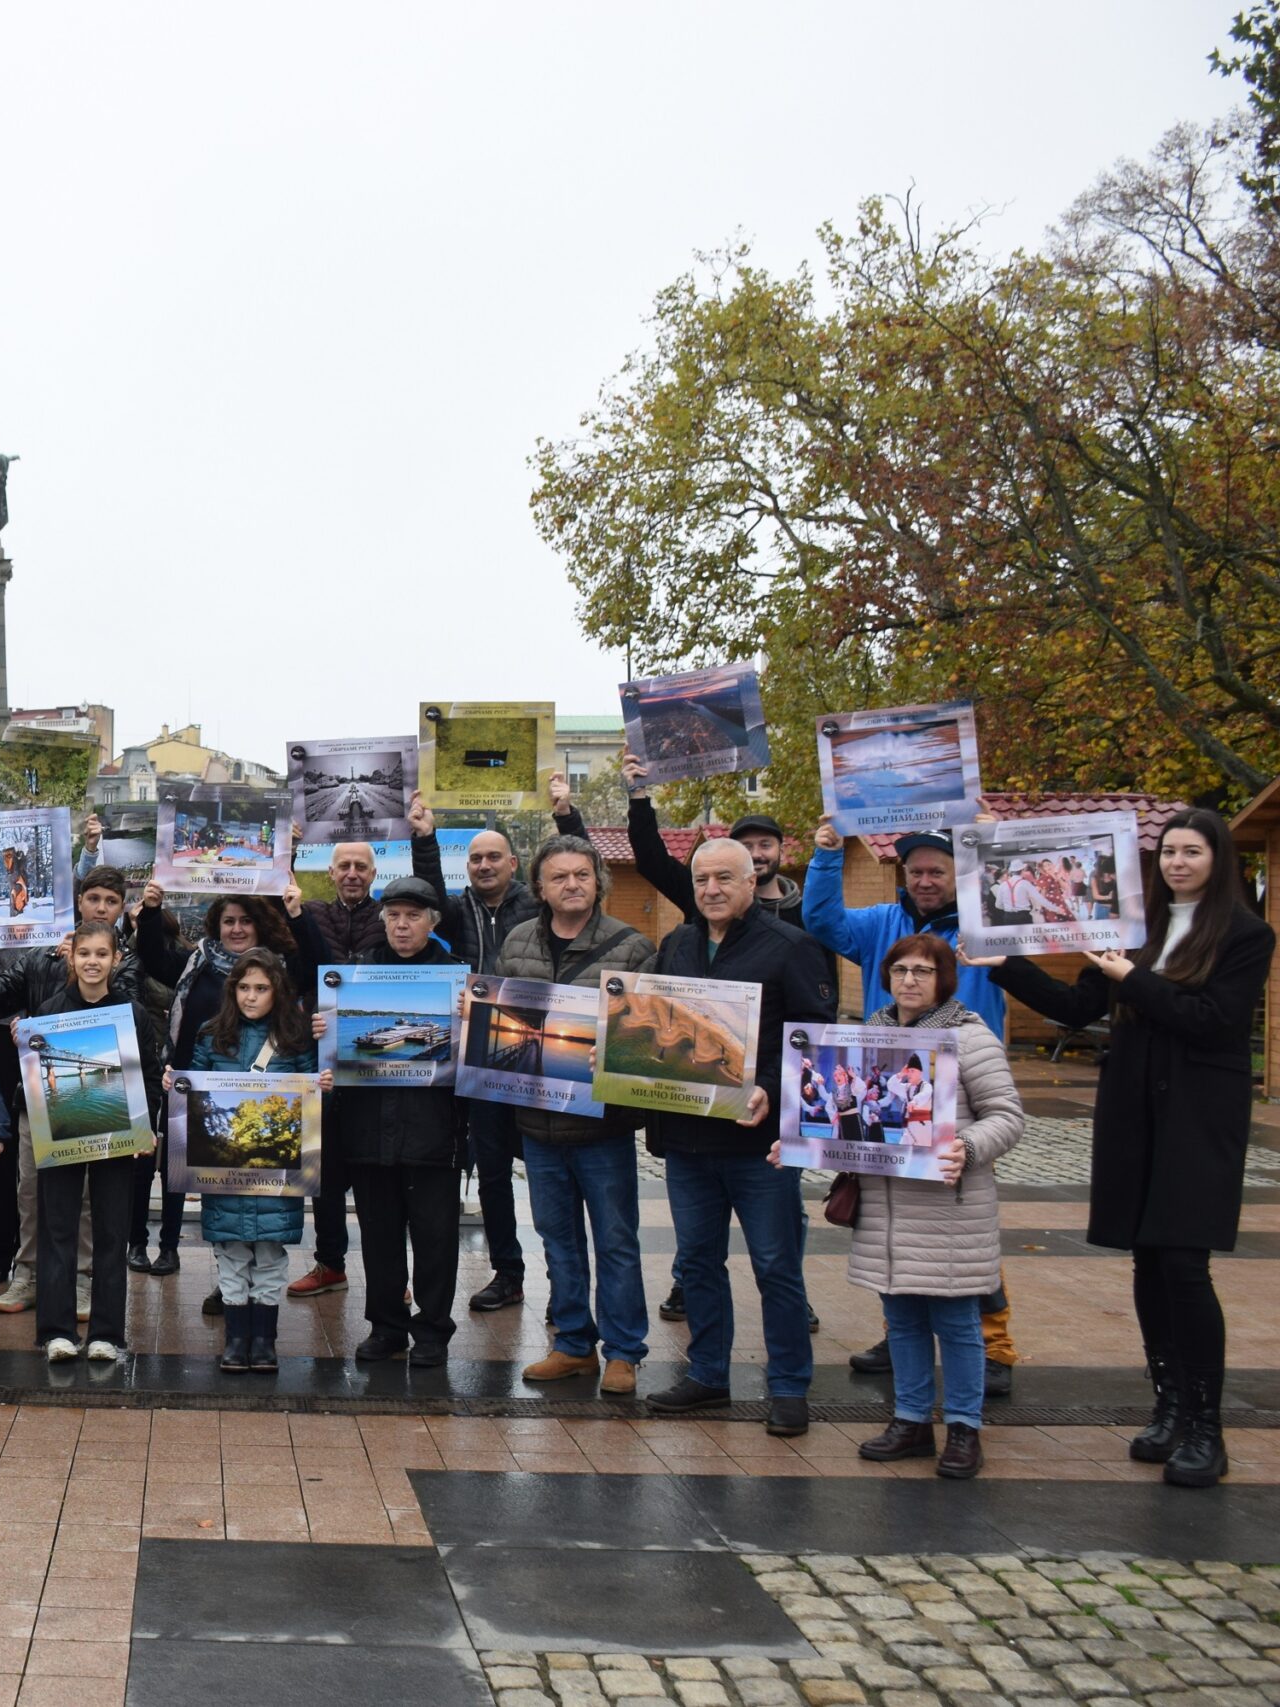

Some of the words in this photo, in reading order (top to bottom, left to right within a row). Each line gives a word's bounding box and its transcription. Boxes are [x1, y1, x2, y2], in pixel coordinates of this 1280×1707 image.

[857, 815, 889, 825] ПЕТЪР
[891, 811, 946, 823] НАЙДЕНОВ
[213, 877, 254, 885] ЧАКЪРЯН
[20, 931, 61, 940] НИКОЛОВ
[985, 933, 1049, 947] ЙОРДАНКА
[1051, 930, 1120, 943] РАНГЕЛОВА
[687, 987, 706, 995] РУСЕ“
[838, 1036, 876, 1044] „ОБИЧАМЕ
[357, 1069, 389, 1077] АНГЕЛ
[390, 1069, 432, 1077] АНГЕЛОВ
[484, 1081, 535, 1095] МИРОСЛАВ
[538, 1089, 576, 1101] МАЛЧЕВ
[630, 1087, 667, 1100] МИЛЧО
[670, 1091, 710, 1105] ЙОВЧЕВ
[51, 1145, 82, 1159] СИБЕЛ
[83, 1139, 135, 1153] СЕЛЯЙДИН
[823, 1150, 861, 1161] МИЛЕН
[863, 1154, 905, 1165] ПЕТРОВ
[196, 1176, 244, 1185] МИКАЕЛА
[245, 1177, 291, 1187] РАЙКОВА
